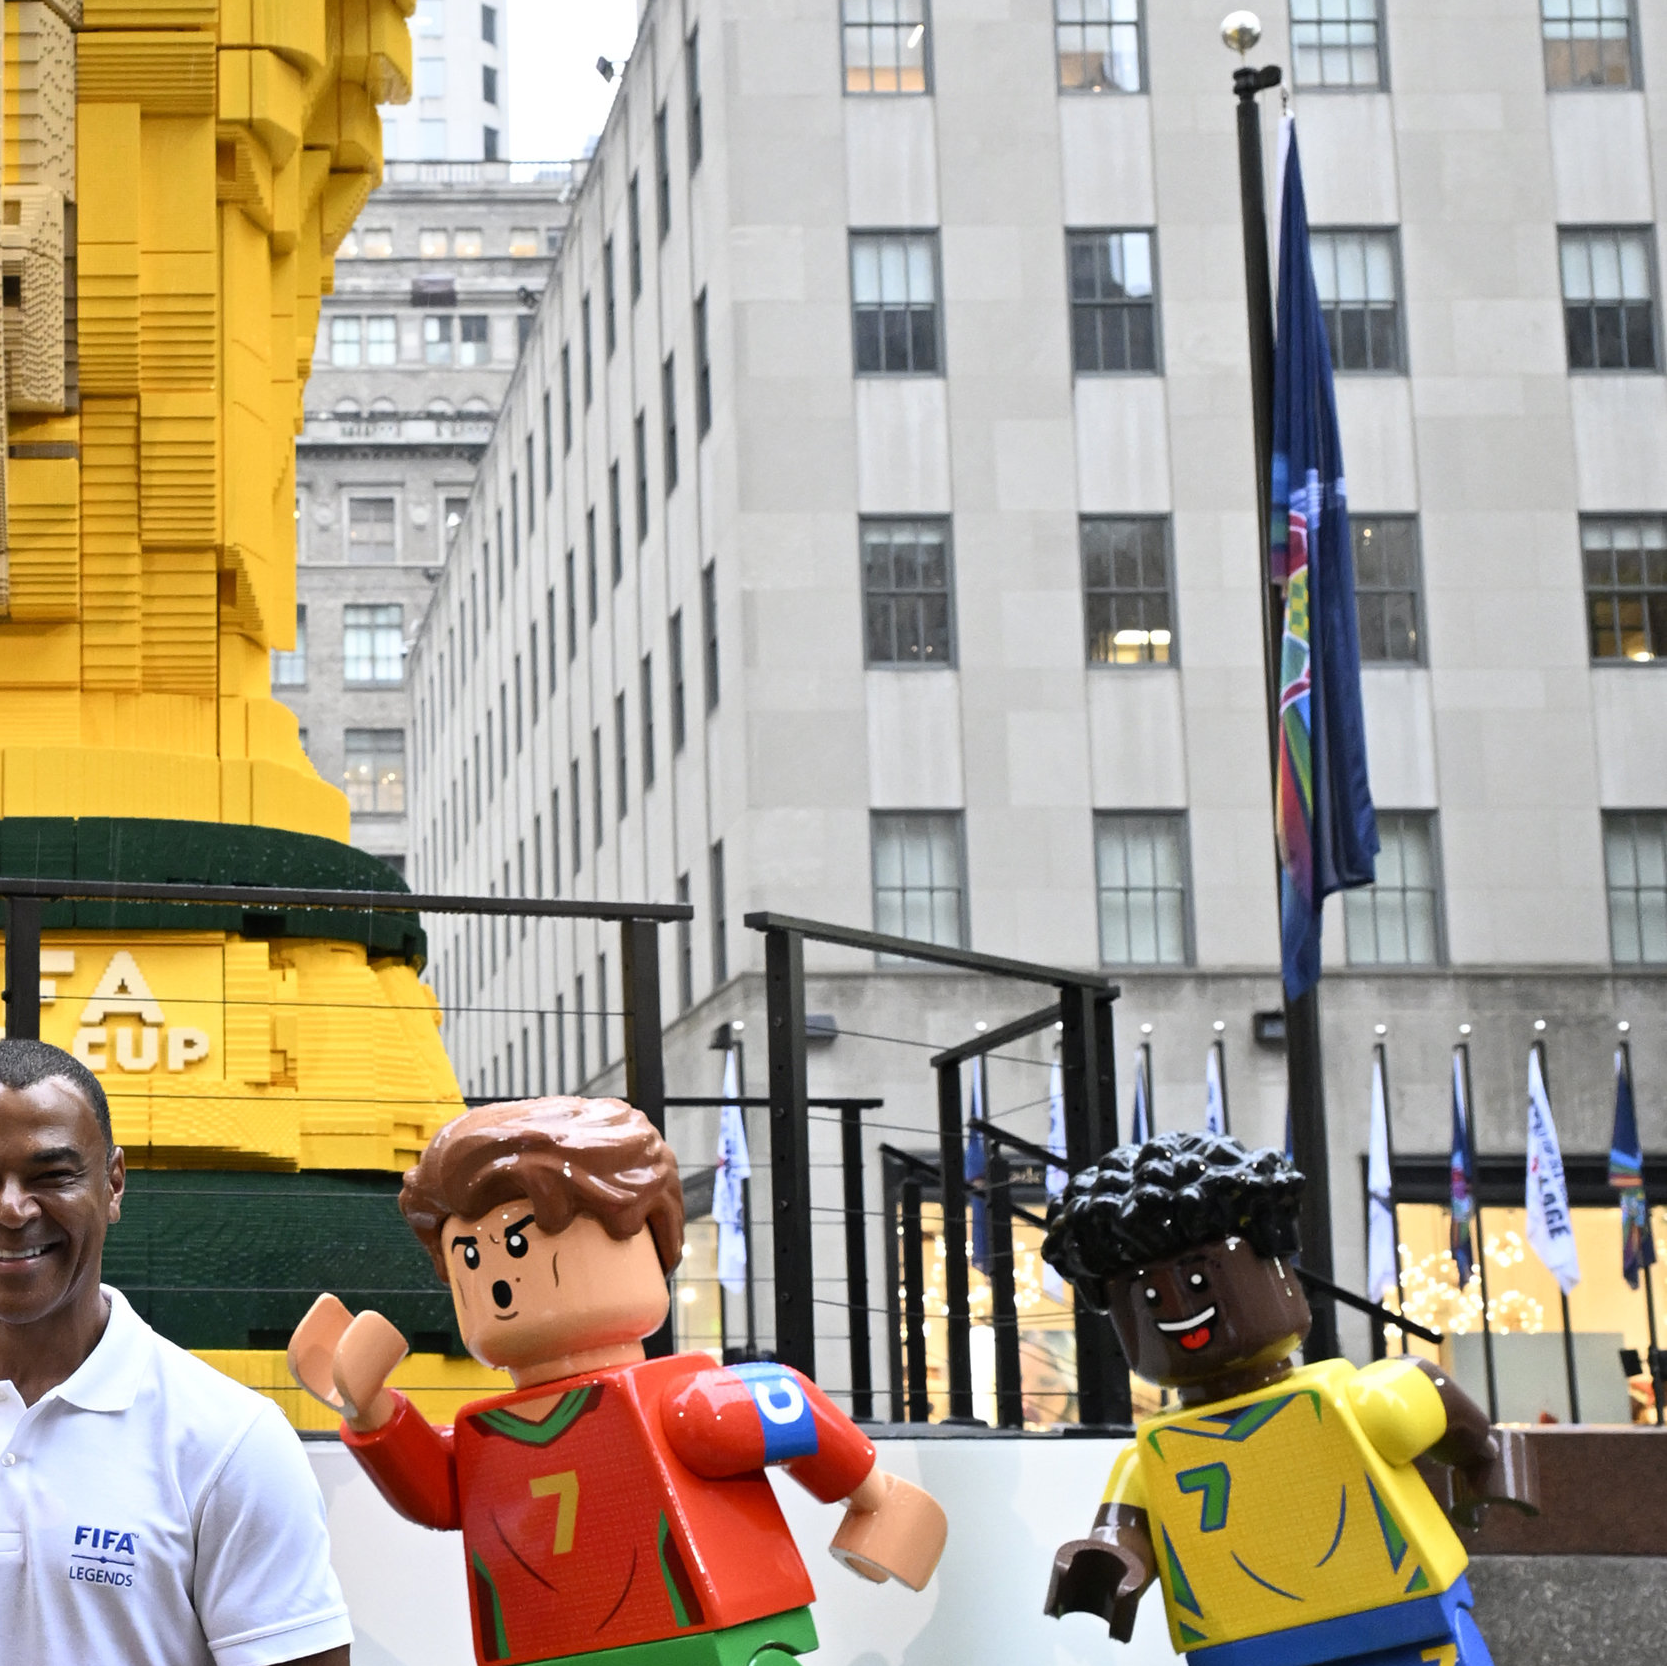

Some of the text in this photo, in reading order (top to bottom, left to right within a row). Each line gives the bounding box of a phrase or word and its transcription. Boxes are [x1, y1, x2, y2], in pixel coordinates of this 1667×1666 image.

[72, 1026, 210, 1073] CUP
[755, 1377, 804, 1425] C
[529, 1469, 579, 1555] 7
[1175, 1461, 1231, 1533] 7
[69, 1566, 133, 1587] LEGENDS
